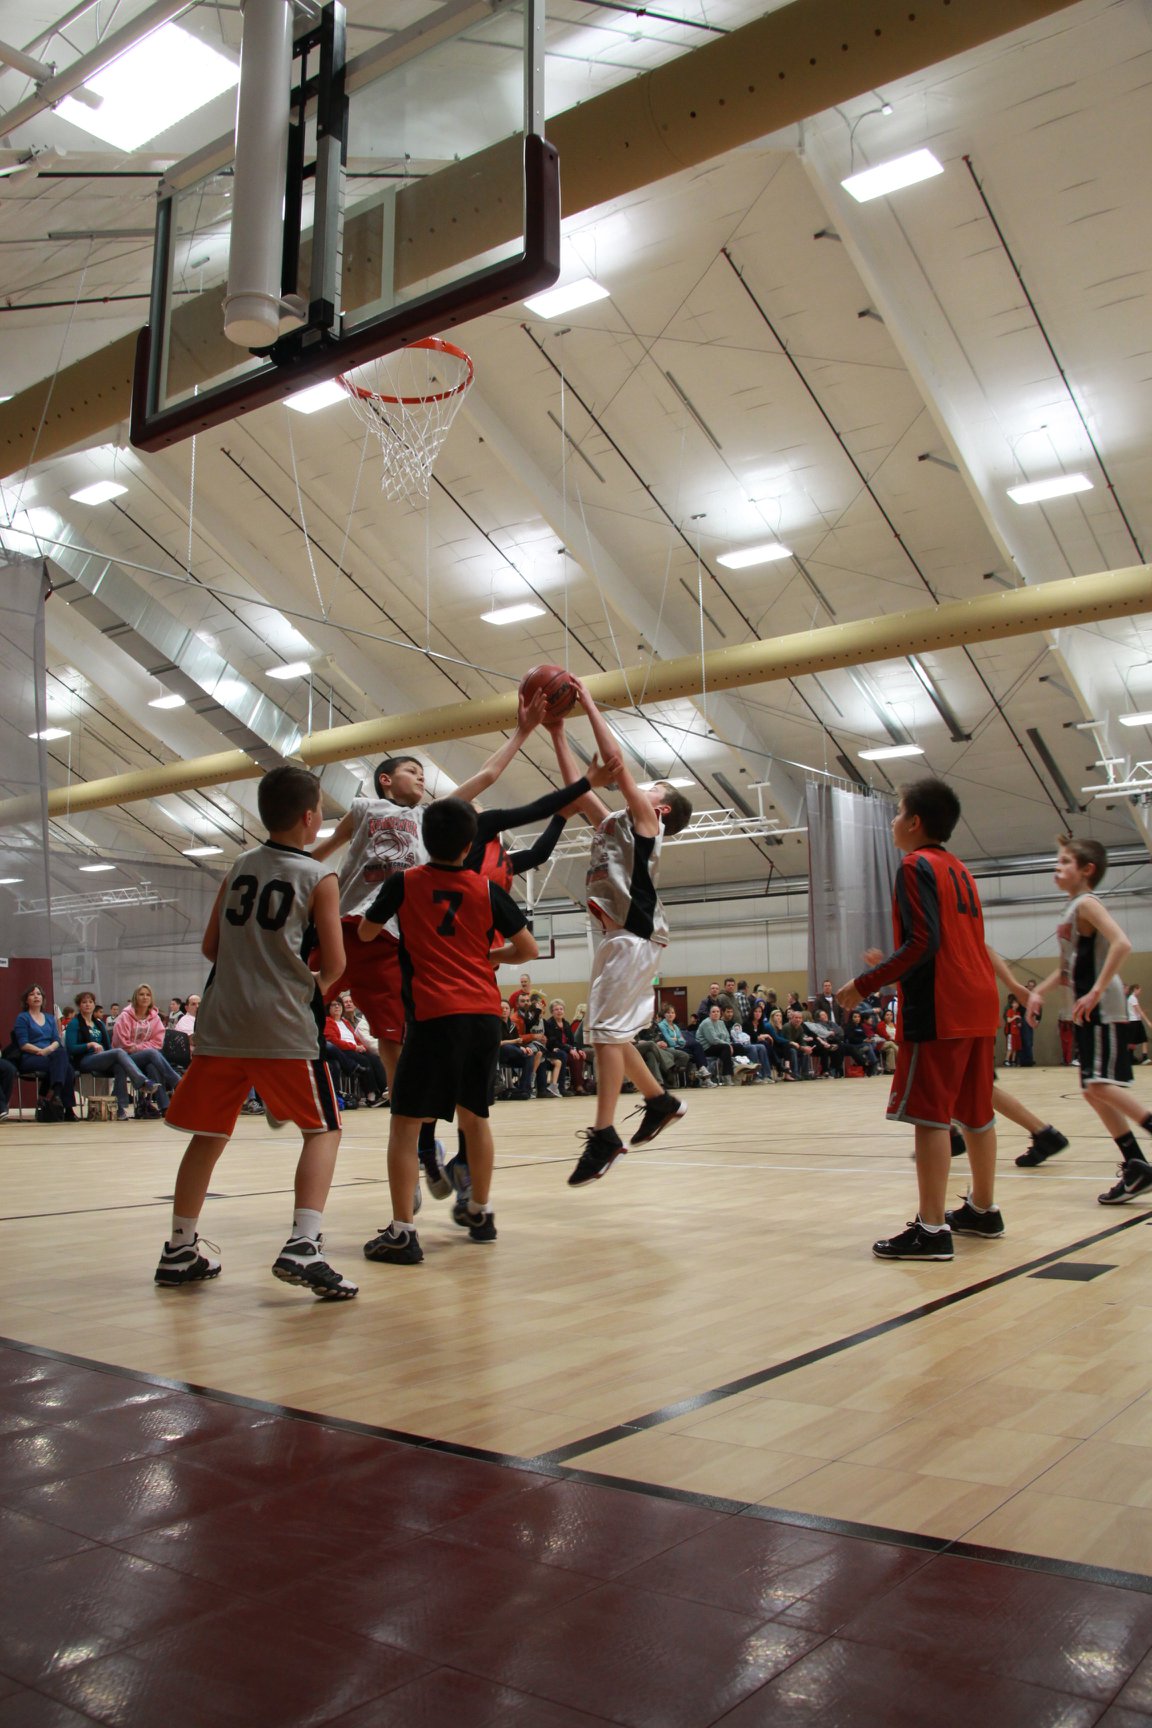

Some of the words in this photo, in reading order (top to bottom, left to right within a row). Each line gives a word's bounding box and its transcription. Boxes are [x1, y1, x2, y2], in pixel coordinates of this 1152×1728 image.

[225, 874, 295, 932] 30
[432, 889, 464, 937] 7
[948, 866, 979, 918] 11
